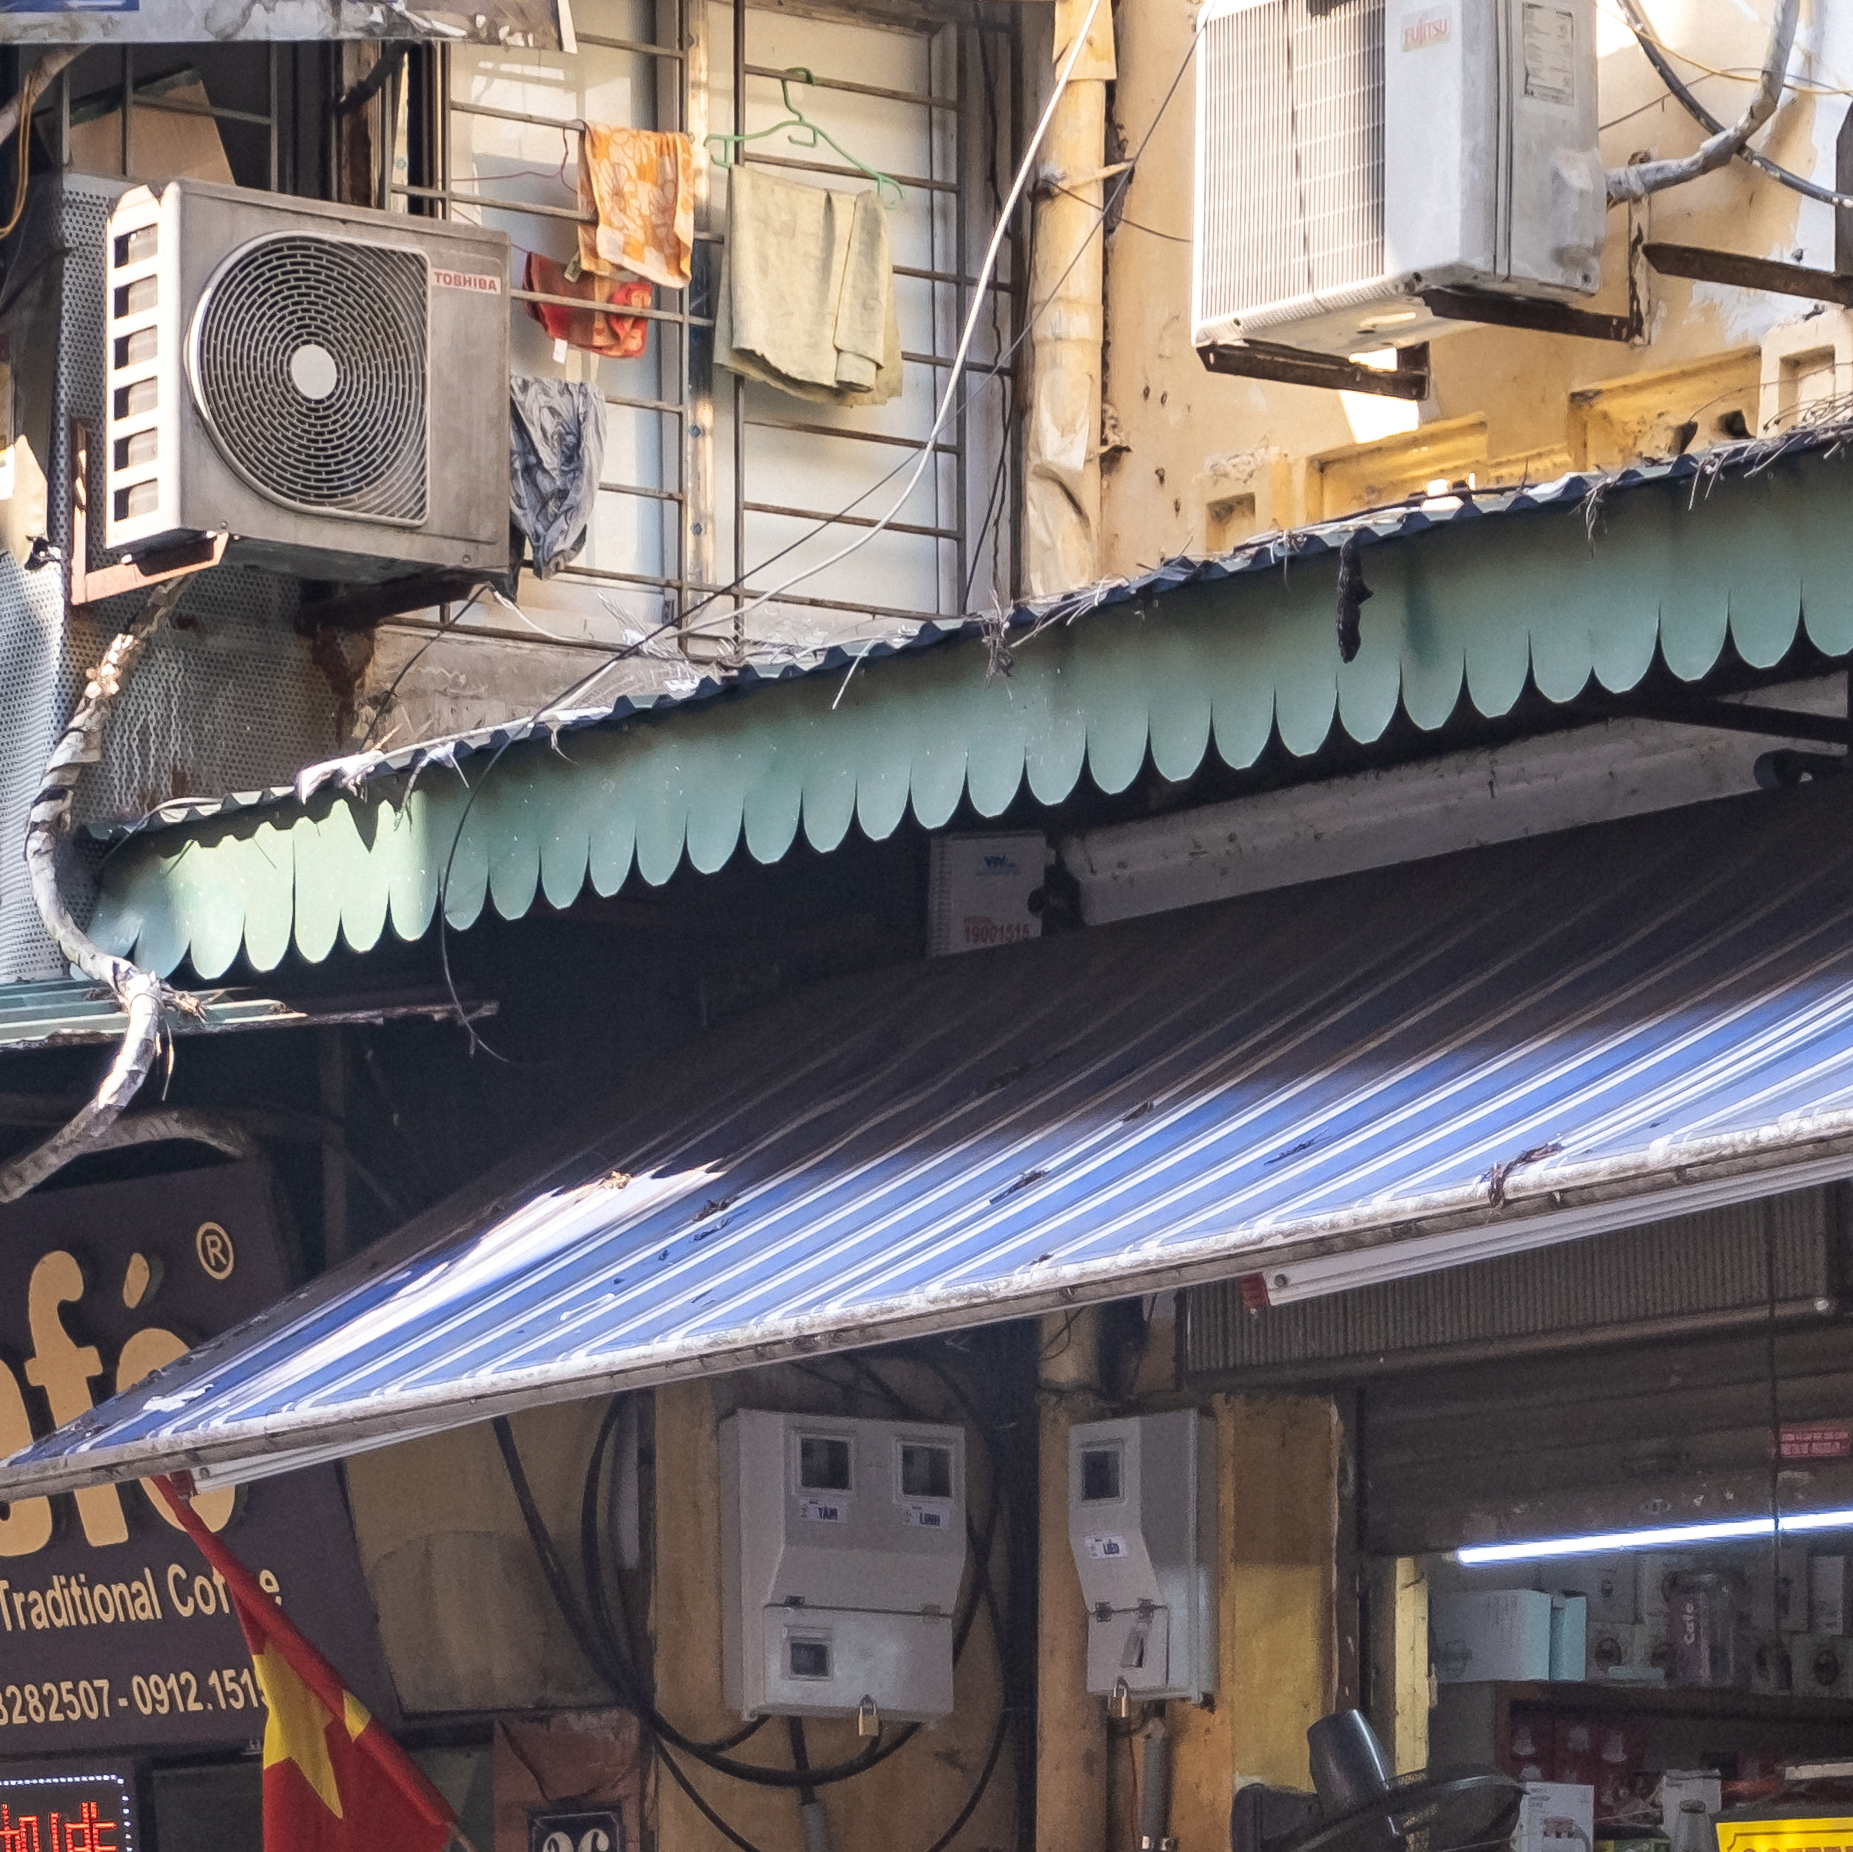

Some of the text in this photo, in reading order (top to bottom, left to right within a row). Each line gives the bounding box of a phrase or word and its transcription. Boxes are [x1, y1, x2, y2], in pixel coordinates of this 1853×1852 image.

[1404, 12, 1448, 45] FUJITSU
[434, 272, 497, 291] TOSHIBA
[167, 1563, 282, 1618] Cofe
